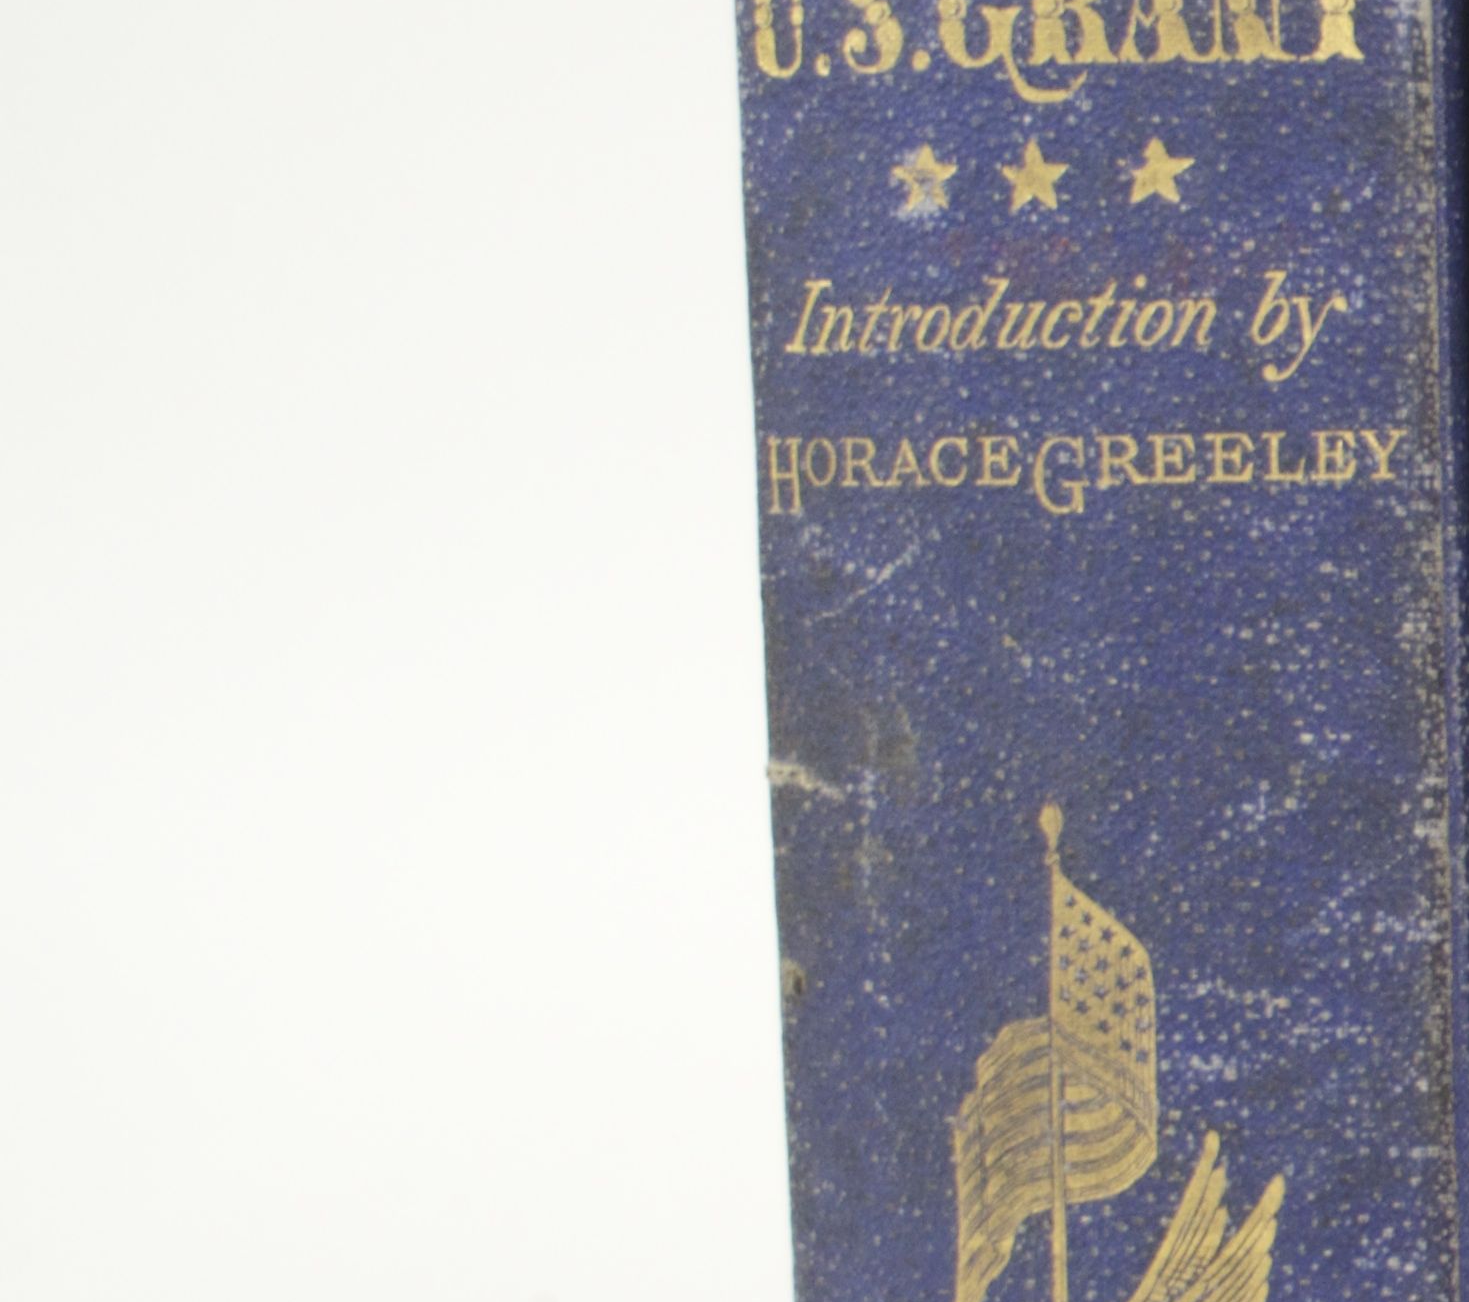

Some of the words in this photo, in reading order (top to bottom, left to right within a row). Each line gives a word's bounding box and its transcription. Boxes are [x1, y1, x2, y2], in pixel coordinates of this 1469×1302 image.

[785, 278, 1217, 355] Introduction
[1250, 270, 1348, 382] by
[766, 434, 1023, 515] HORACE
[1034, 430, 1408, 515] GREELEY
